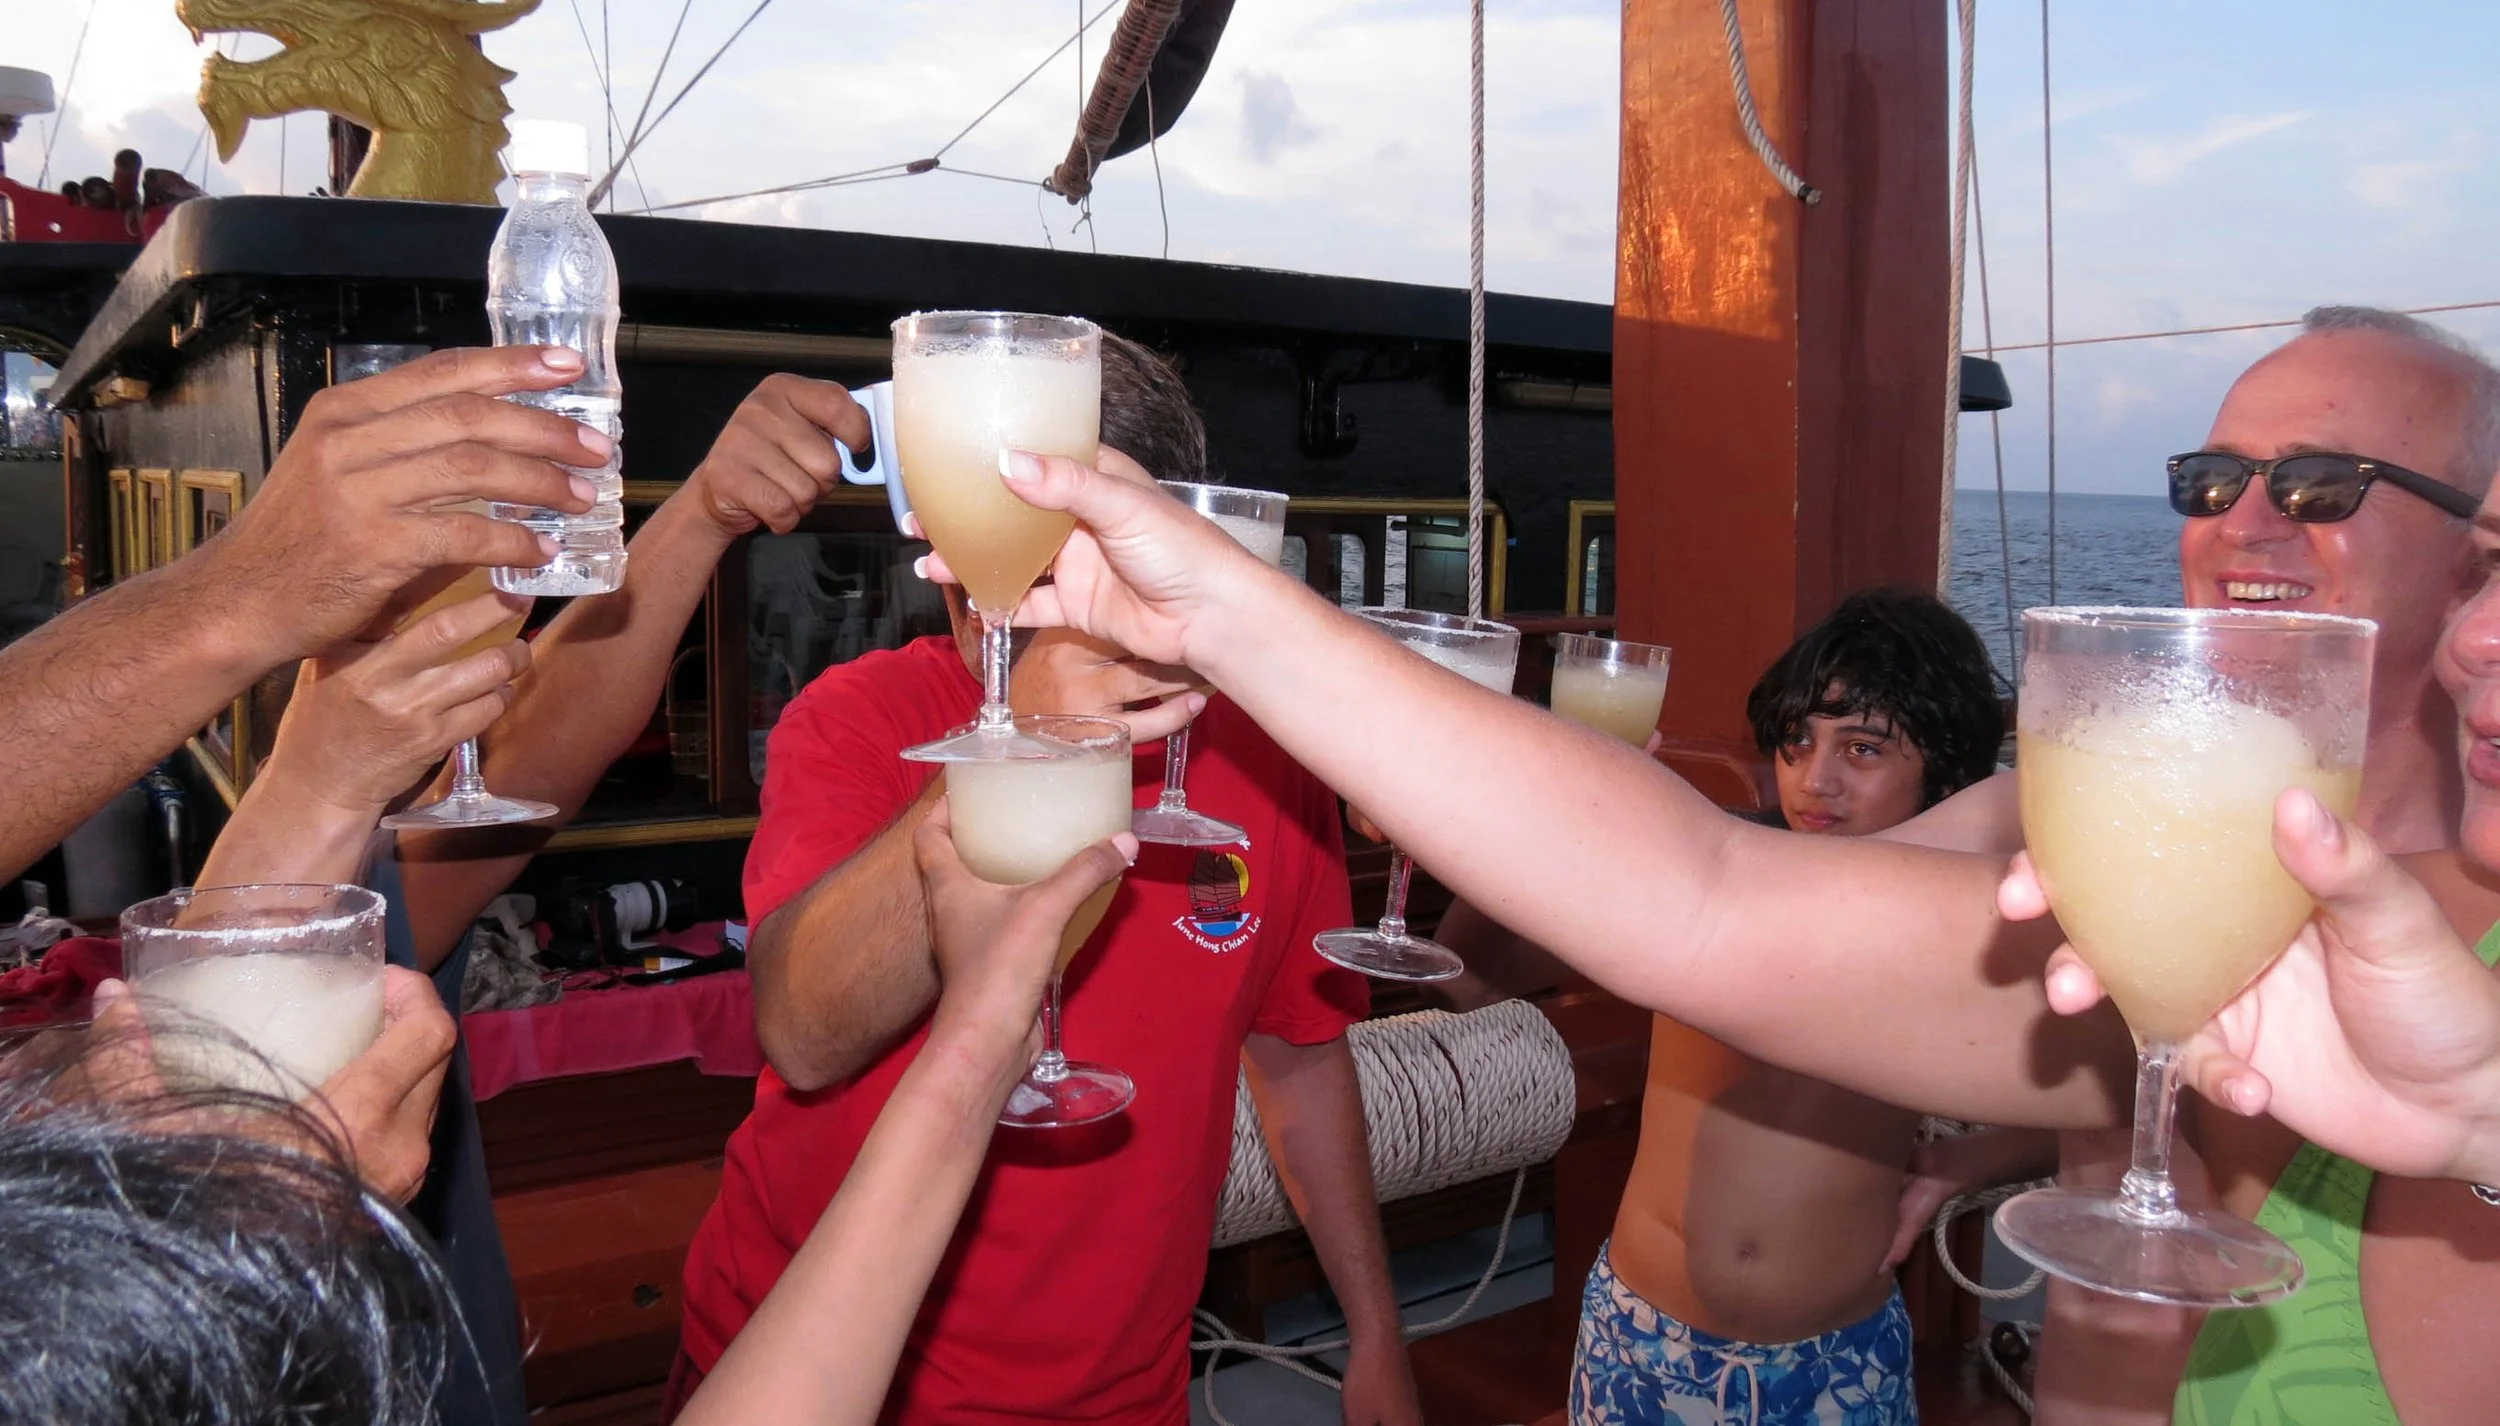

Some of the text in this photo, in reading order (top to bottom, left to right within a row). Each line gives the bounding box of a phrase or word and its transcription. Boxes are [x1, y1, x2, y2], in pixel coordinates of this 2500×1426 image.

[1172, 916, 1195, 941] June
[1222, 933, 1249, 953] Chian
[1247, 916, 1262, 934] Lee
